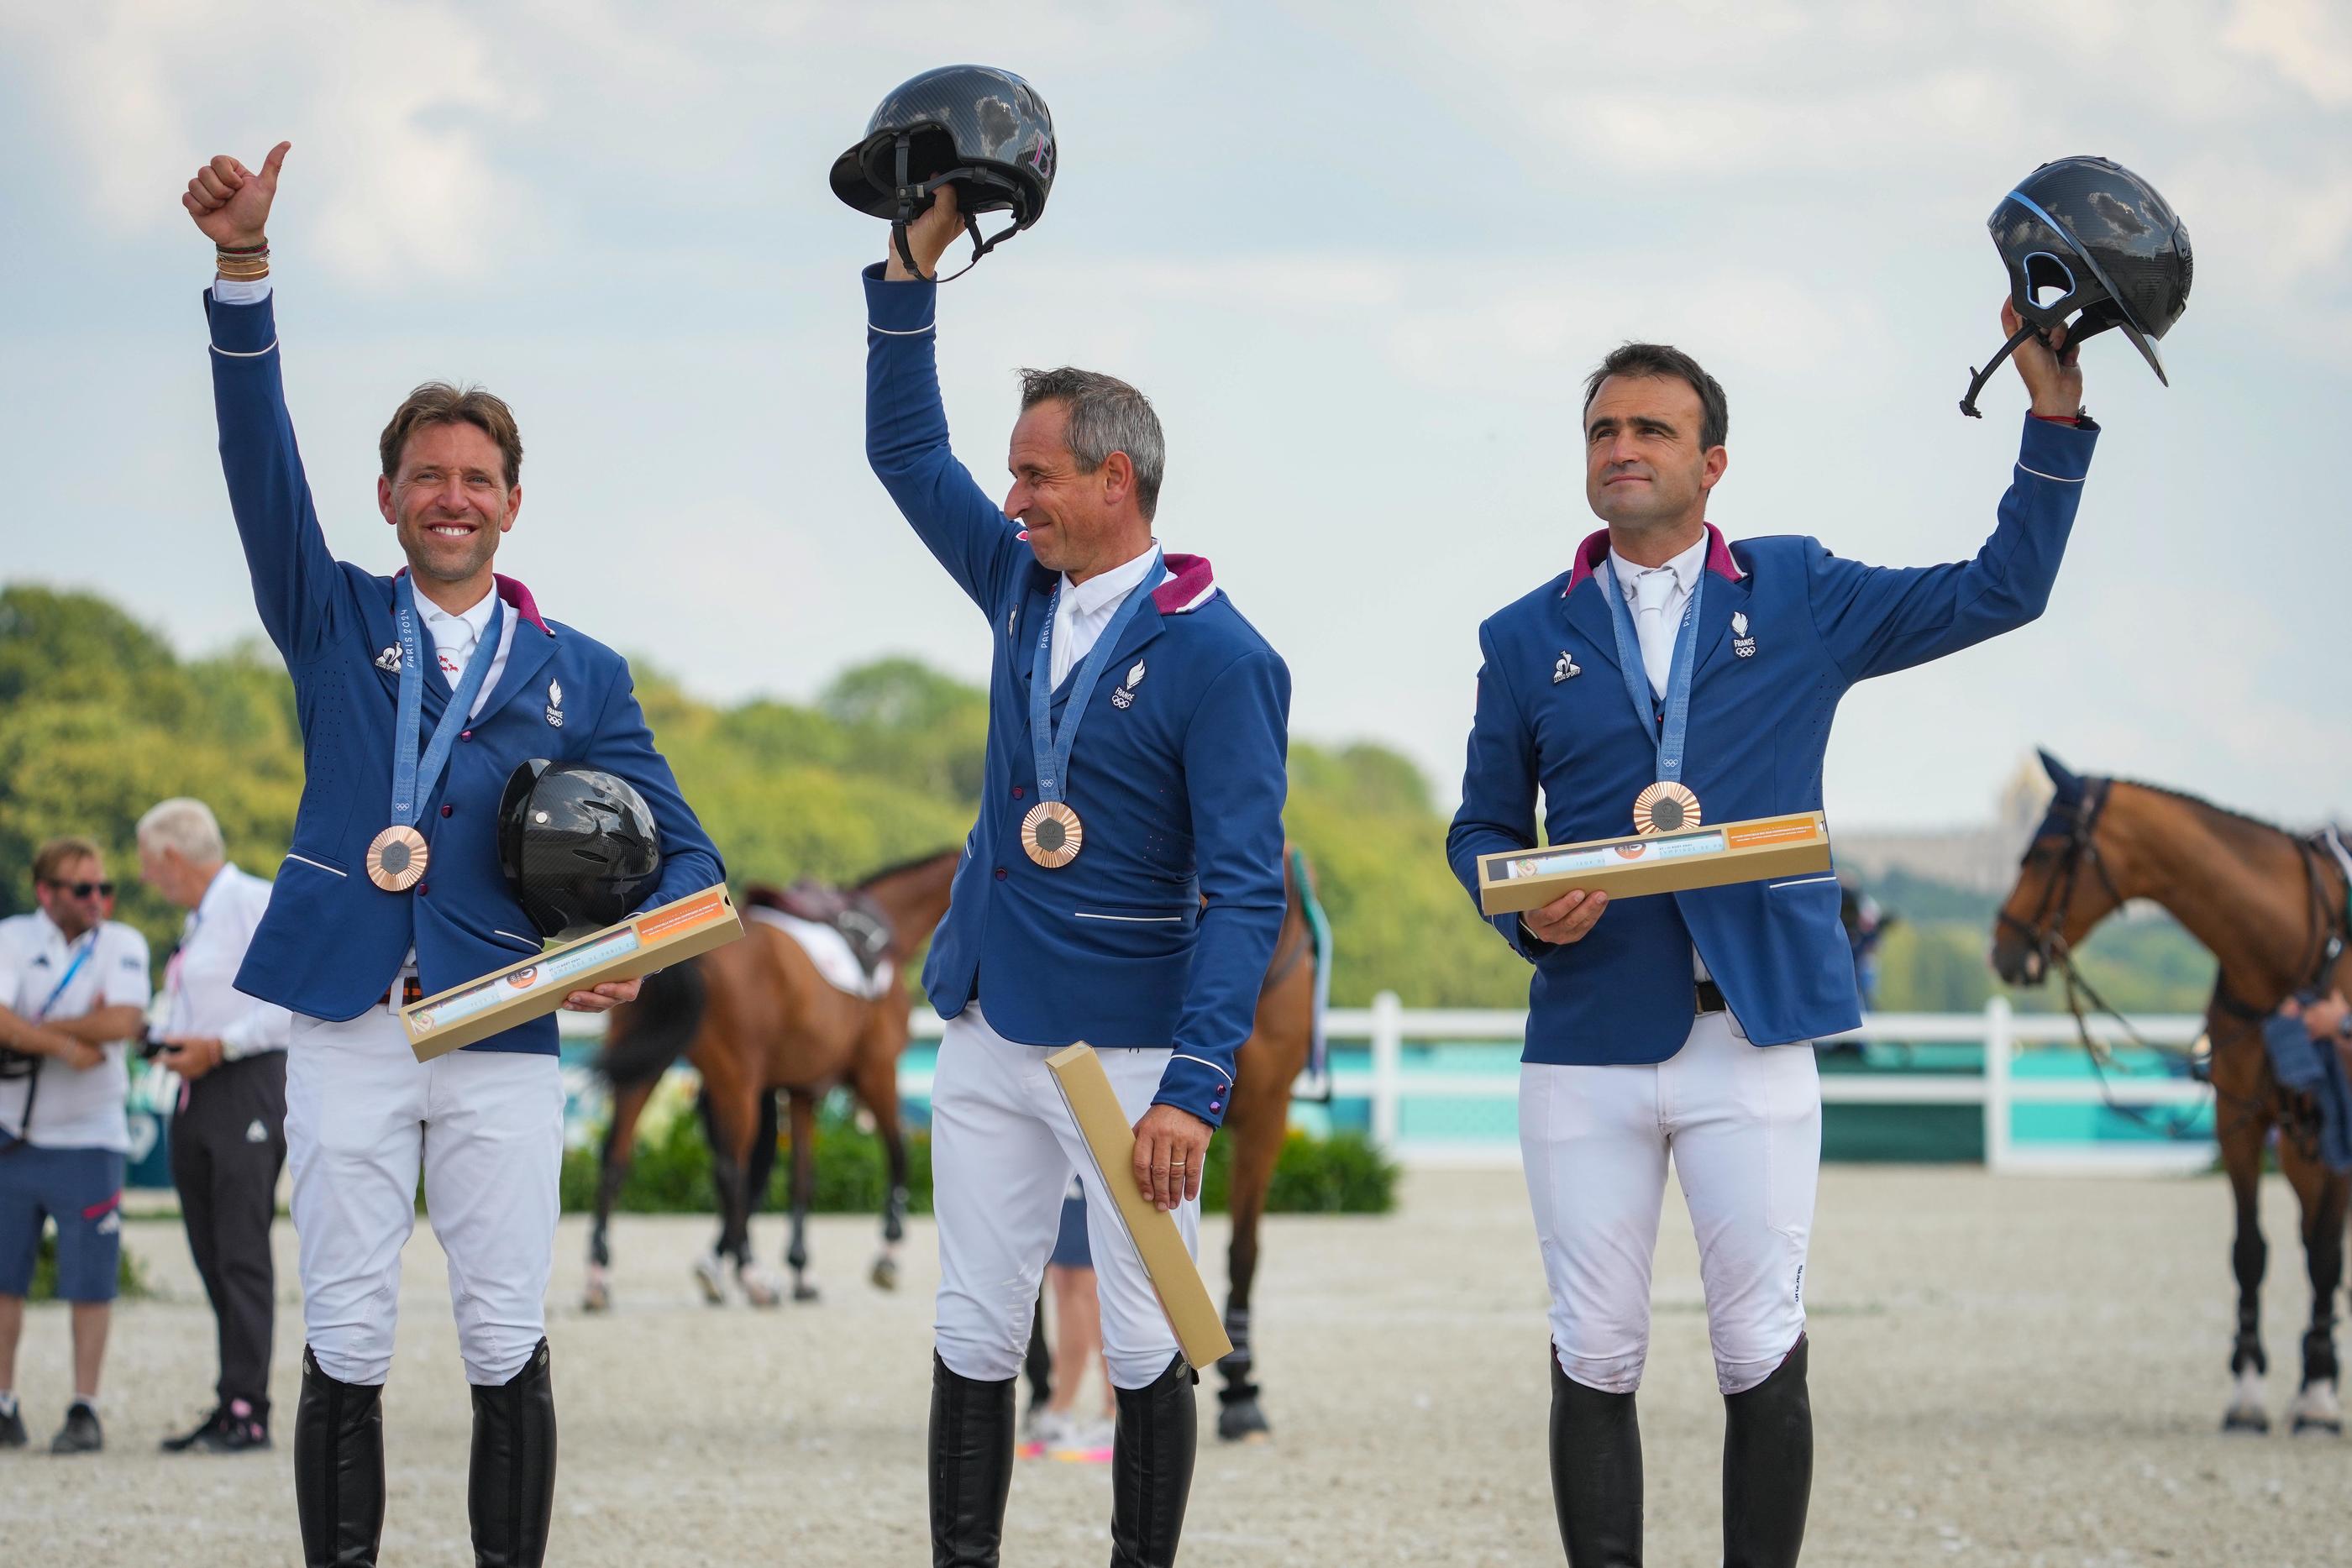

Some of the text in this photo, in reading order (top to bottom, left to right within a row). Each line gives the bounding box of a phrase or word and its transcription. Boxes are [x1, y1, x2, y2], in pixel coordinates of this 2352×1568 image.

[1041, 590, 1058, 648] PARIS 2024
[400, 609, 414, 669] PARIS 2024
[1734, 637, 1755, 648] FRANCE
[1115, 686, 1135, 702] FRANCE
[546, 705, 563, 719] FRANCE
